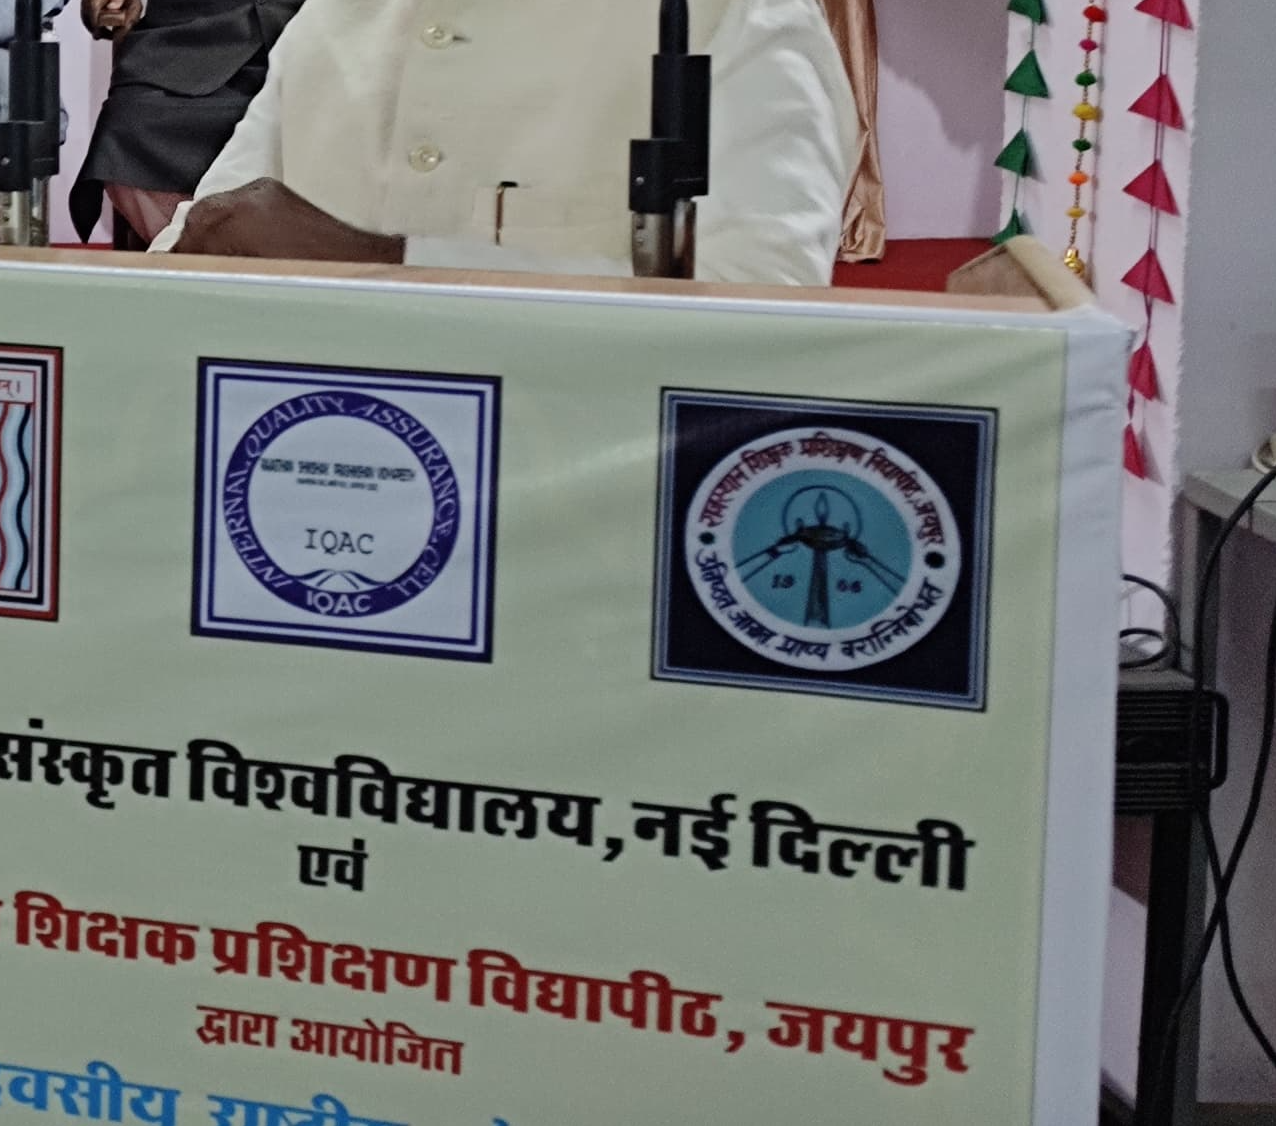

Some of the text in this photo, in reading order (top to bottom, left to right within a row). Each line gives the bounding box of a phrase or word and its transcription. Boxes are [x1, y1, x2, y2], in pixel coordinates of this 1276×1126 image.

[225, 395, 456, 596] INTERNAL QUALITY ASSURANCE CELL
[305, 528, 374, 555] IQAC
[306, 591, 372, 615] IQAC
[297, 838, 367, 892] एवं
[751, 800, 975, 891] दिल्ली
[14, 890, 198, 966] शिक्षक
[211, 921, 458, 1004] प्रशिक्षण
[466, 948, 746, 1054] विद्यापीठ,
[765, 1000, 975, 1086] जयपुर
[196, 1004, 464, 1076] द्वारा आयोजित
